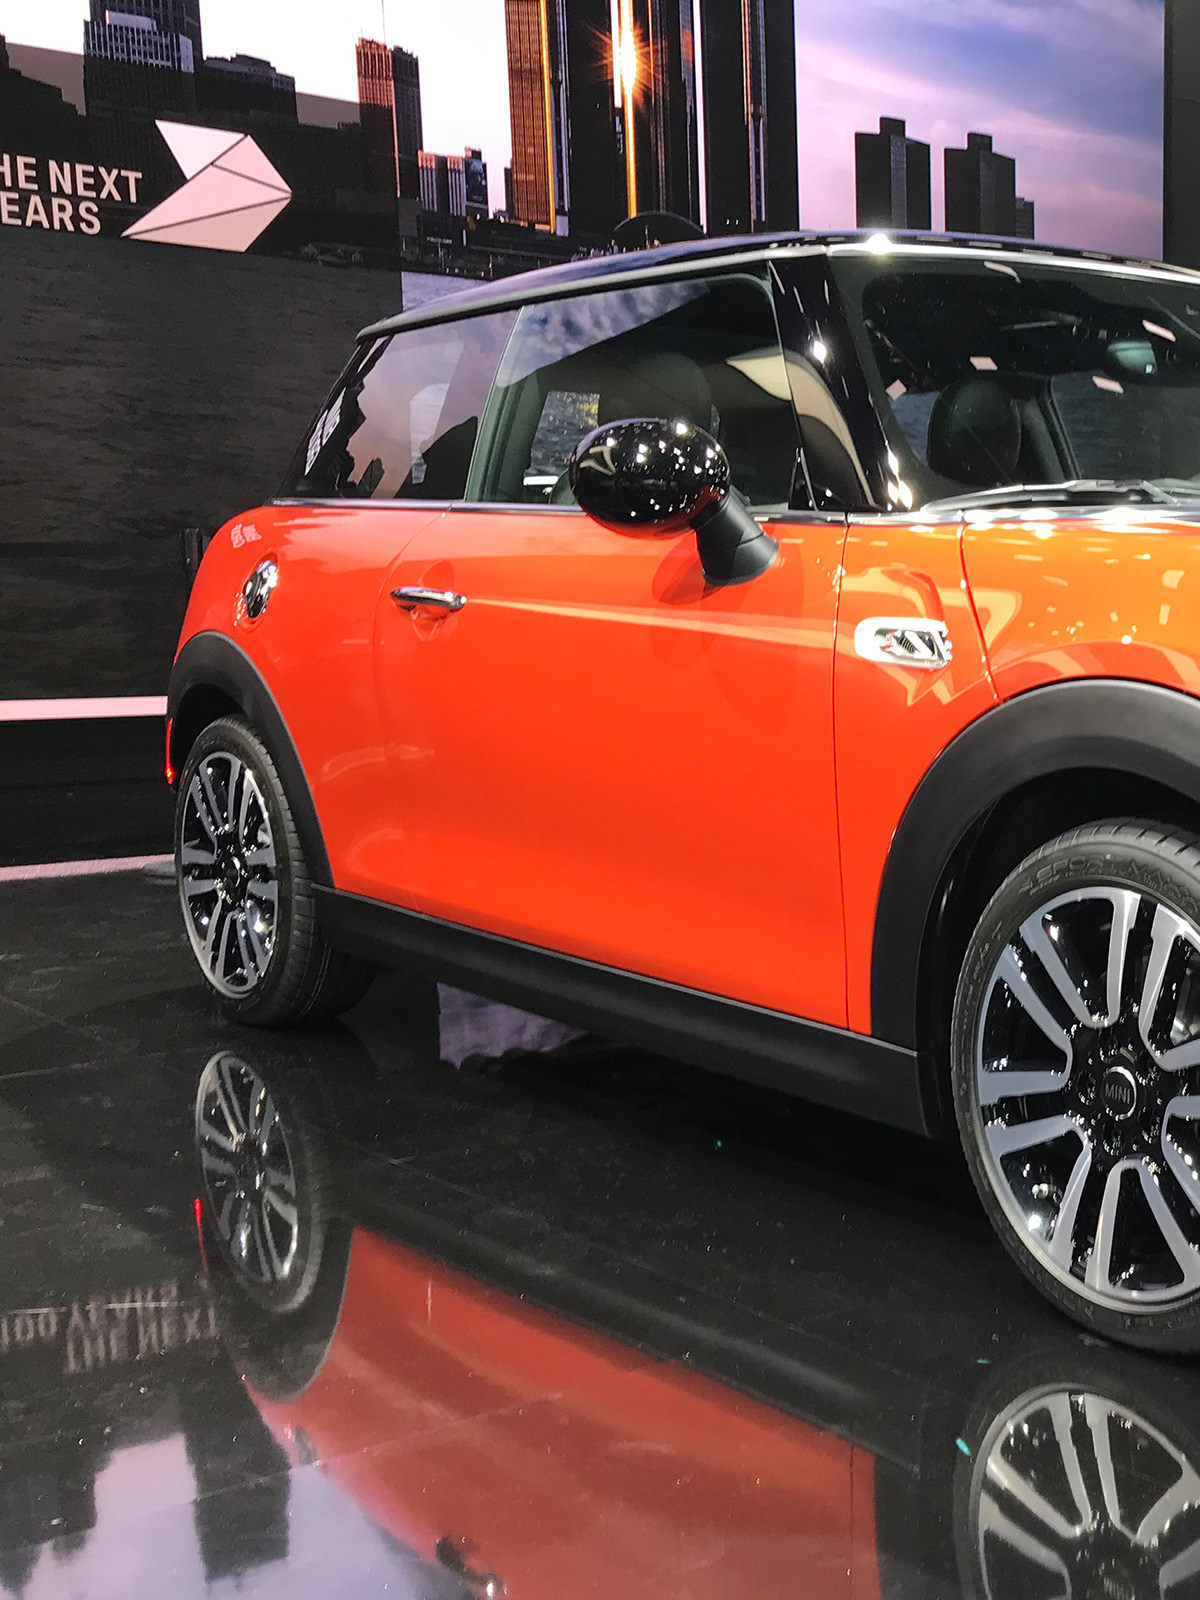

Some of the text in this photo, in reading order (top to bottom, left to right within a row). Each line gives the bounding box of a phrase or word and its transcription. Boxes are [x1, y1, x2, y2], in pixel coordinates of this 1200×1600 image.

[48, 159, 143, 204] NEXT
[0, 190, 101, 236] EARS
[1104, 1082, 1131, 1105] MINI
